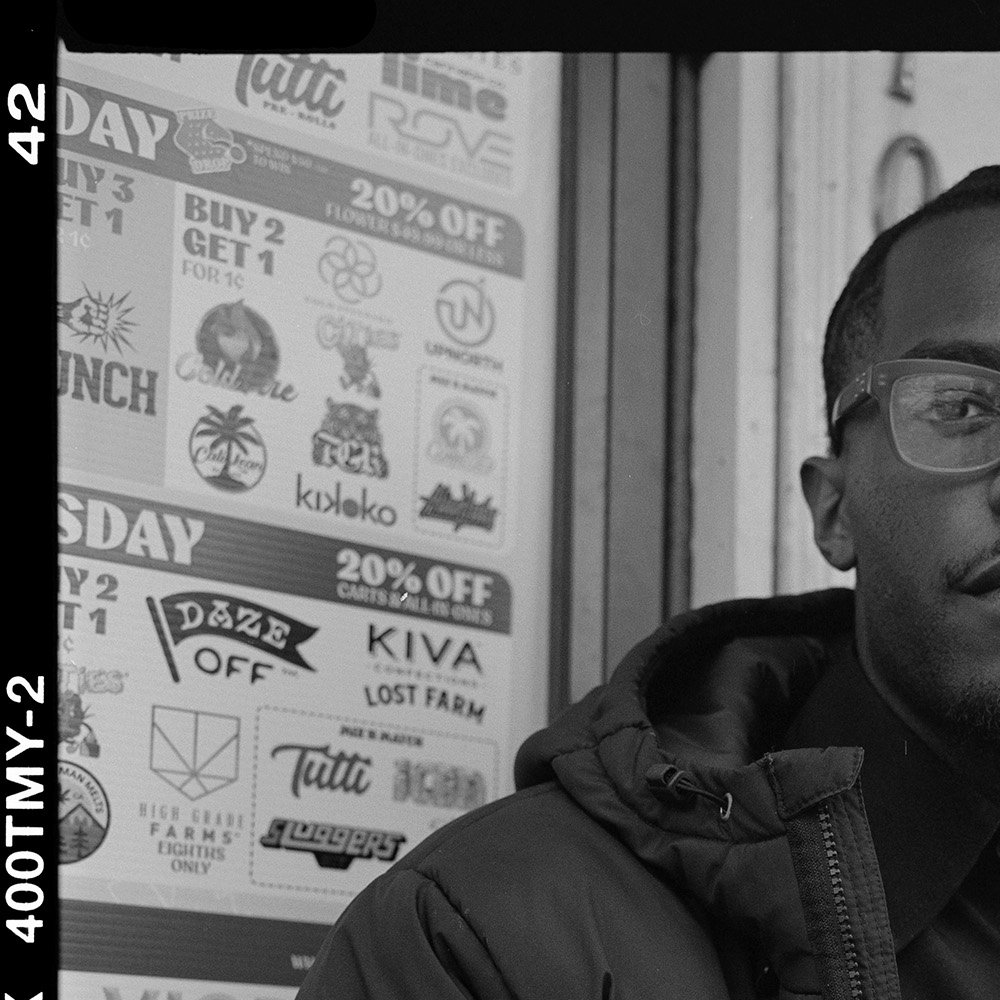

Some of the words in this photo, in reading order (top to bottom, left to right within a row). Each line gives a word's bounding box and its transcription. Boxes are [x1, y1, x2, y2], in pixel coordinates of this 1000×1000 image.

[57, 85, 169, 161] DAY
[112, 174, 135, 203] 3
[105, 207, 124, 235] 1
[184, 193, 258, 237] BUY
[264, 217, 286, 246] 2
[350, 178, 436, 229] 20%
[439, 203, 506, 248] OFF
[182, 227, 252, 269] GET
[258, 249, 274, 277] 1
[182, 260, 220, 284] FOR
[57, 491, 206, 566] SDAY
[96, 573, 119, 601] 2
[336, 548, 423, 594] 20%
[426, 564, 494, 607] OFF
[89, 607, 107, 635] 1
[174, 599, 292, 650] DAZE
[194, 647, 274, 684] OFF
[368, 623, 484, 676] KIVA
[364, 683, 417, 708] LOST
[425, 686, 486, 724] FARM
[270, 743, 372, 798] Tutti
[139, 802, 180, 821] HIGH
[150, 821, 232, 846] FARMS
[158, 839, 226, 863] EIGHTHS
[170, 858, 212, 875] ONLY
